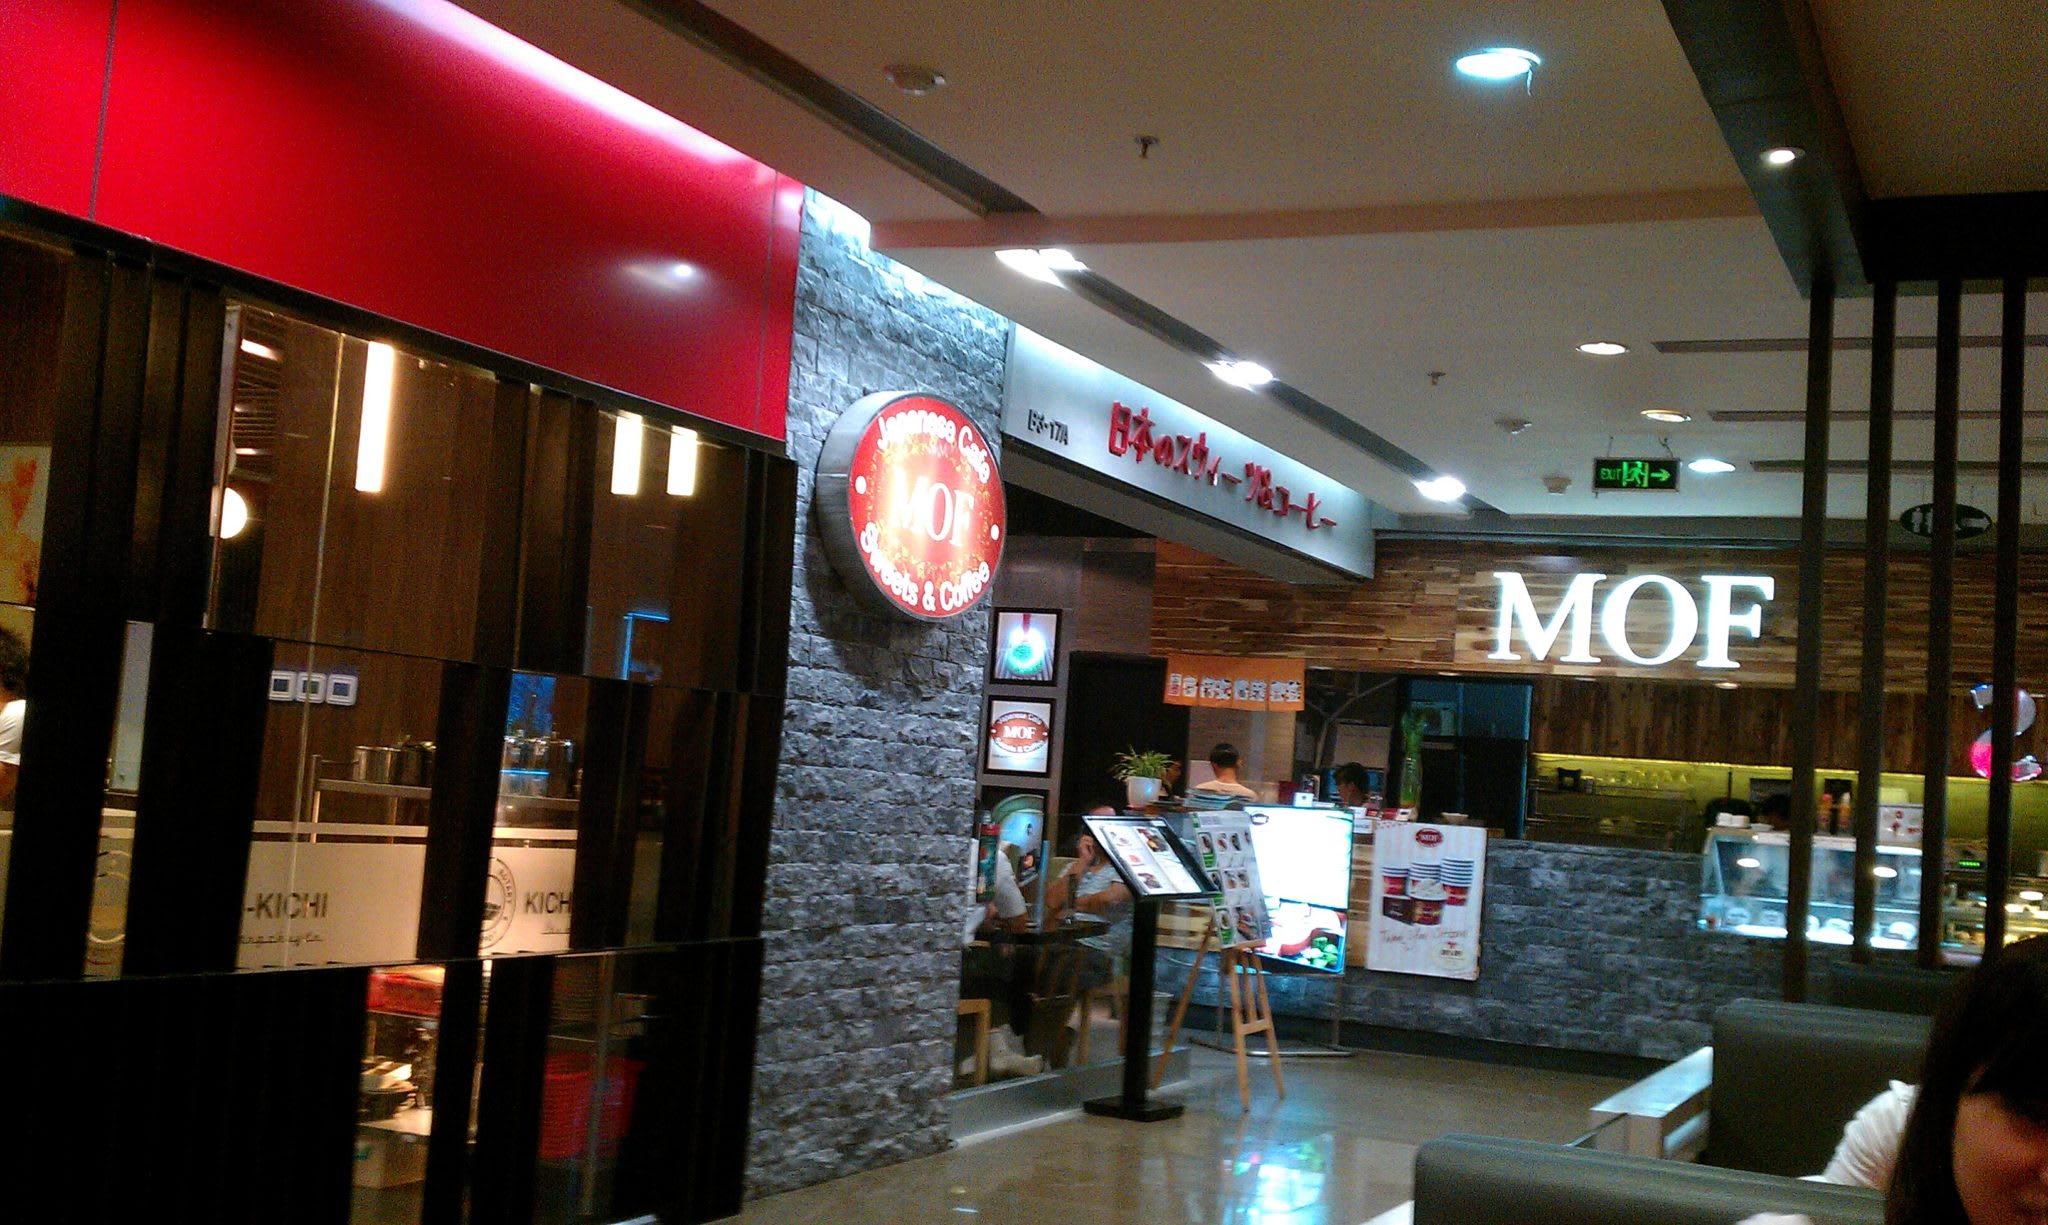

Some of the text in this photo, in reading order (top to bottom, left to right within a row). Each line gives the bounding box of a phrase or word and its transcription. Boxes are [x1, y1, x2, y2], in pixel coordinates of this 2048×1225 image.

[877, 410, 991, 484] Japanese Cafe
[1600, 467, 1622, 480] EXIT
[886, 464, 976, 549] MOF
[860, 521, 990, 612] Sweets & Coffee
[1487, 571, 1776, 669] MOF
[1003, 725, 1037, 740] MOF
